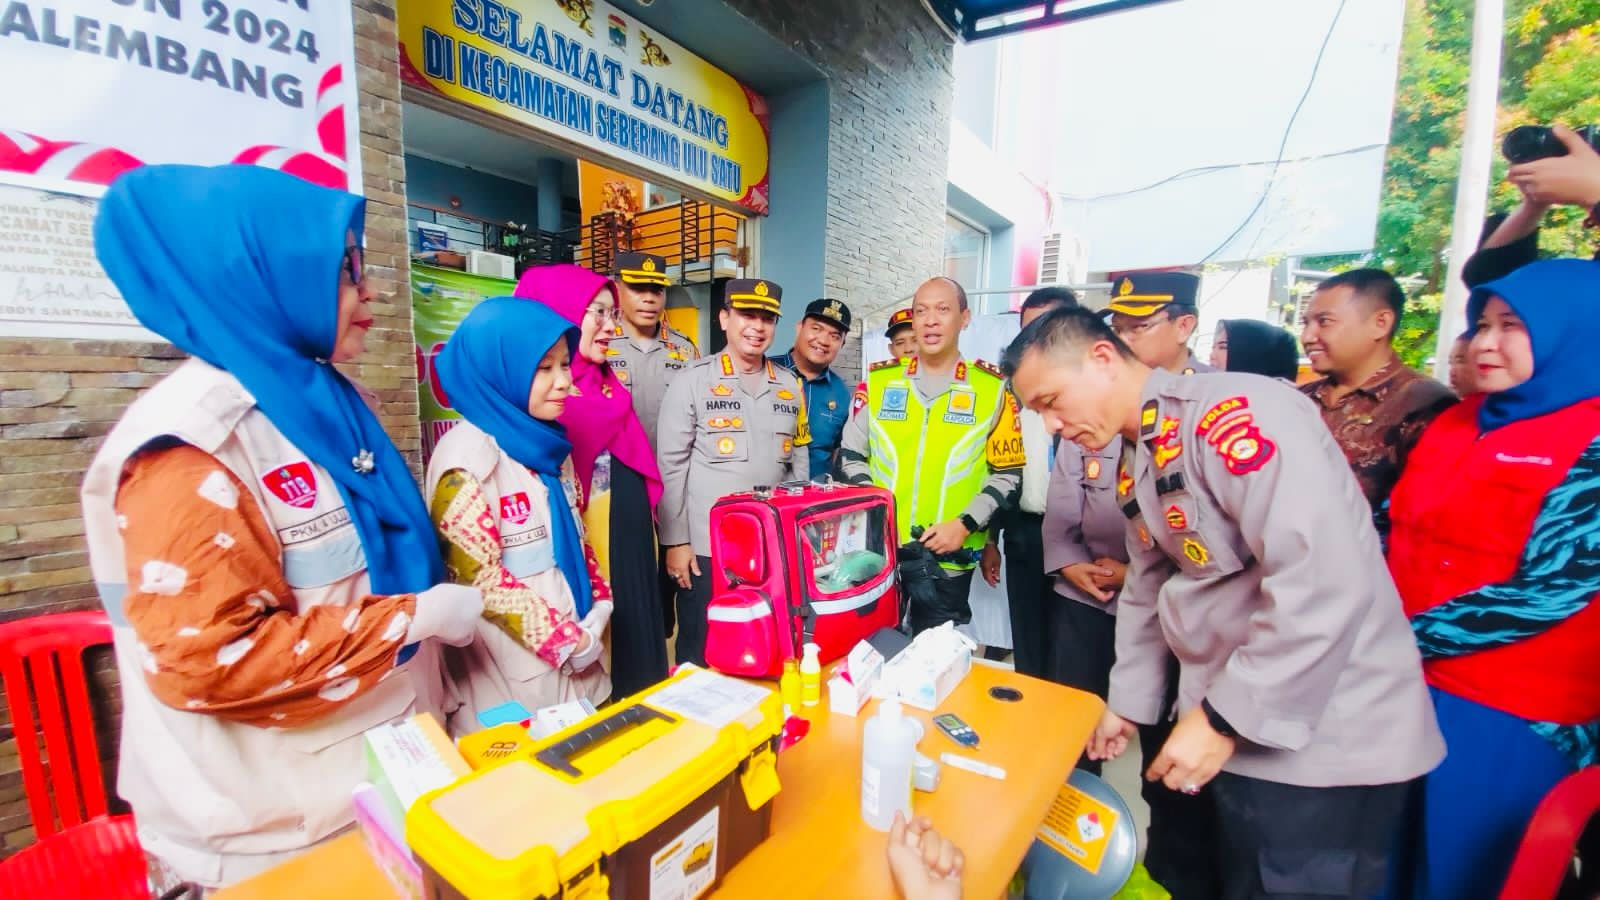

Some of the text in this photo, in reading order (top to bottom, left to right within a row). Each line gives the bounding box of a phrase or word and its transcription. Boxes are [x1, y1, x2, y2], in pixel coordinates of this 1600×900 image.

[202, 0, 320, 64] 2024
[453, 0, 729, 150] SELAMAT DATANG
[423, 25, 742, 195] DI KECAMATAN SEBERANG ULU SATU
[706, 400, 741, 411] HARYO
[1199, 399, 1242, 430] POLDA
[280, 476, 312, 500] 119
[504, 501, 529, 518] 119
